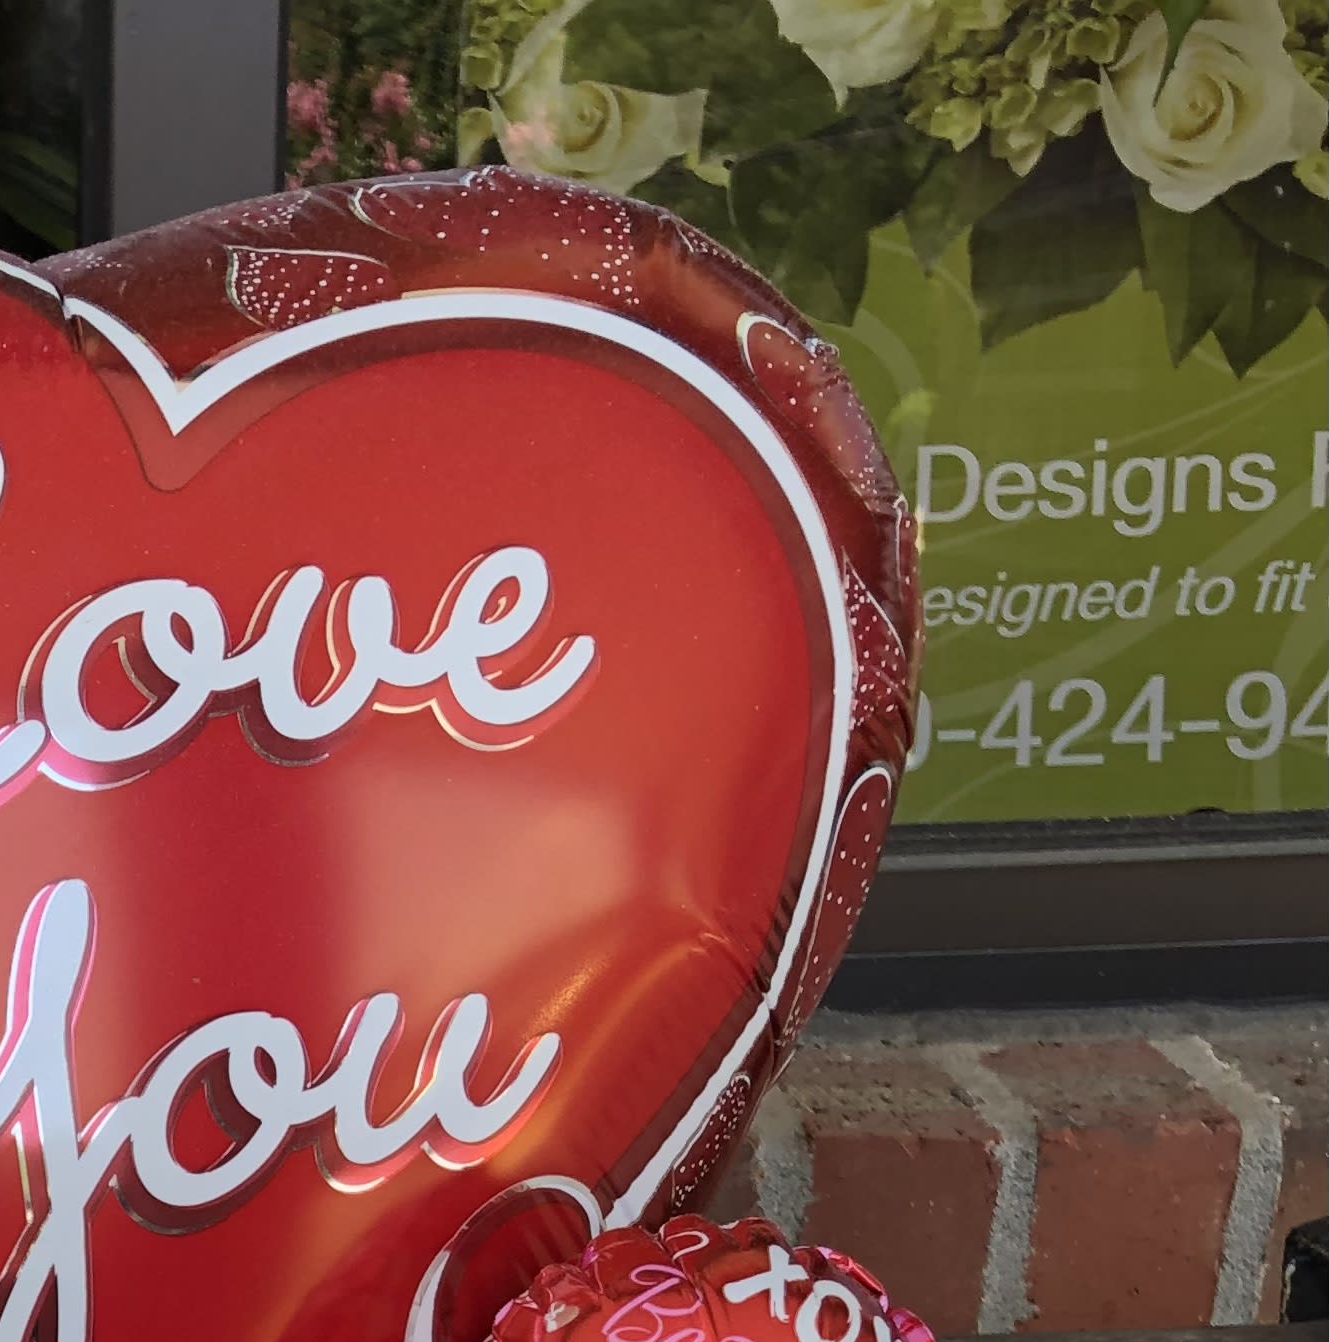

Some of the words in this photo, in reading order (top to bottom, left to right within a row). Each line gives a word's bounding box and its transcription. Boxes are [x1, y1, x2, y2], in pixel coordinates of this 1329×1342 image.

[916, 436, 1277, 538] Designs
[923, 564, 1161, 639] esigned
[1174, 566, 1236, 617] to
[1254, 558, 1318, 613] fit
